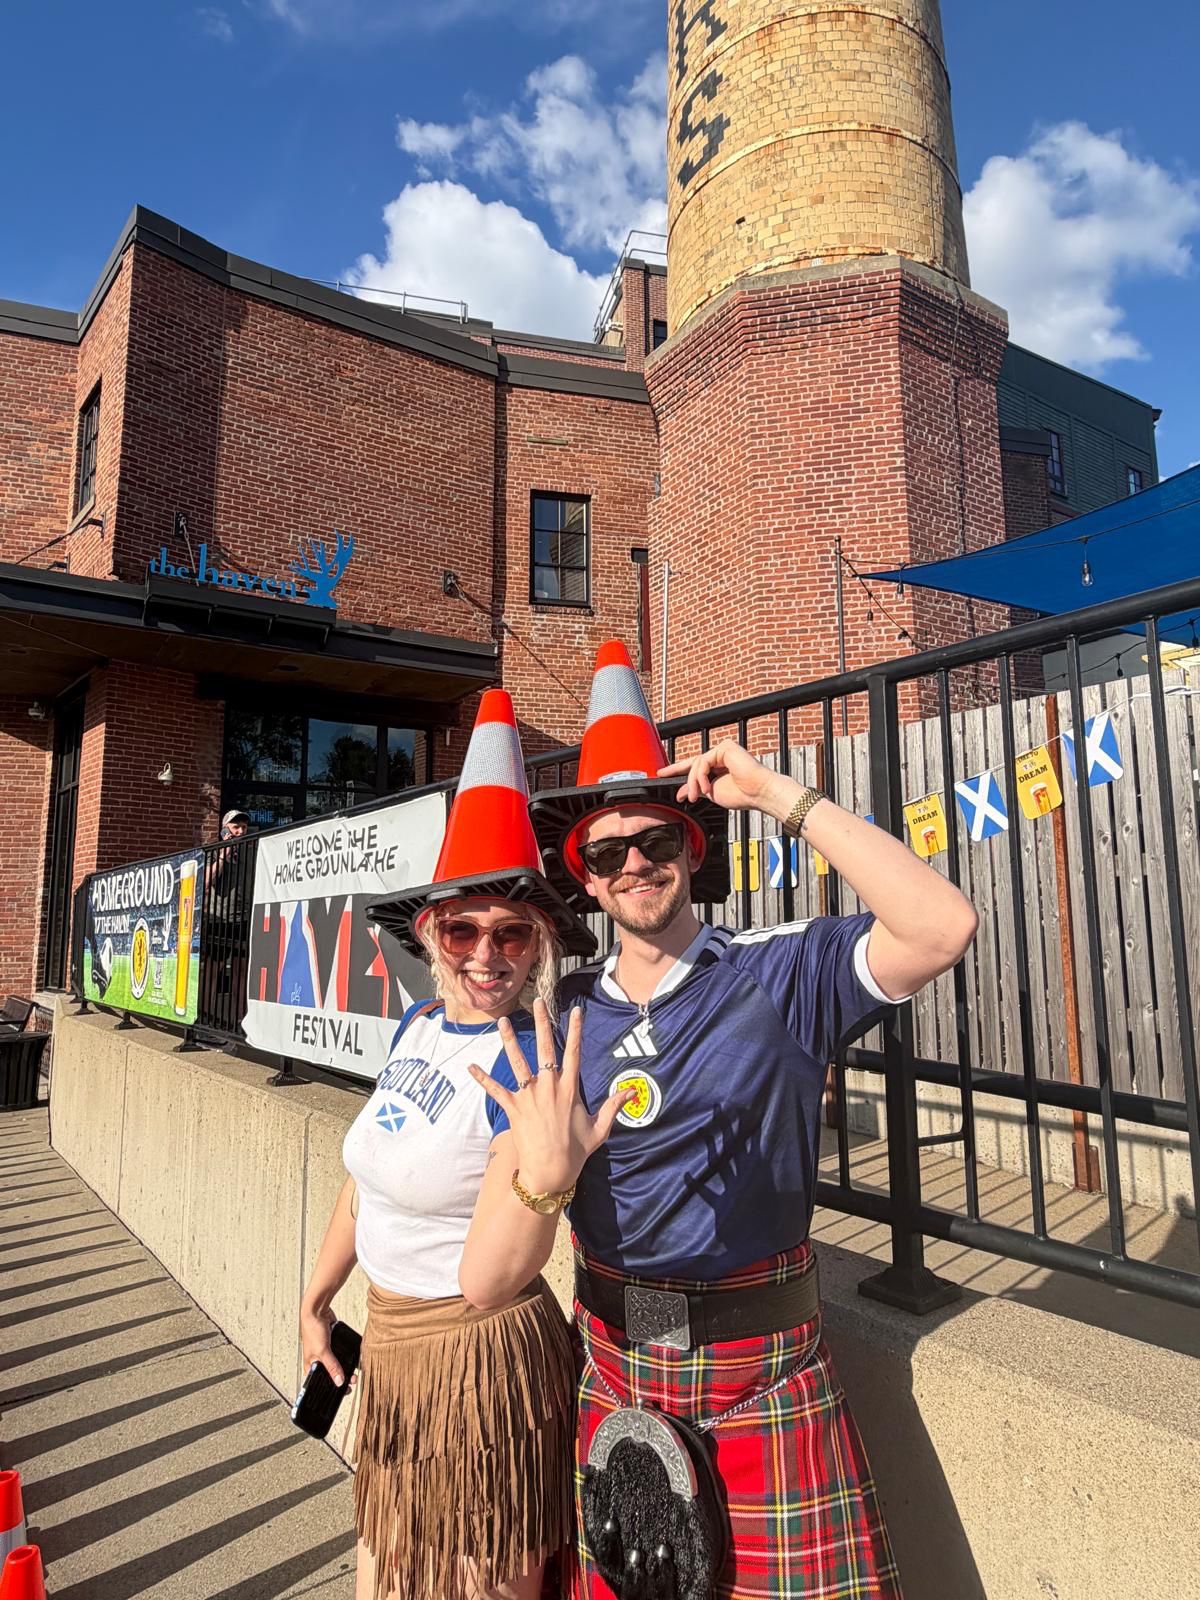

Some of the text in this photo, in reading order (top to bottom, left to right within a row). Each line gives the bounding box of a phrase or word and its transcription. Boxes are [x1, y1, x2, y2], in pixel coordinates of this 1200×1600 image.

[150, 543, 297, 599] the haven
[1018, 764, 1048, 783] DREAM
[912, 810, 938, 825] DREAM
[286, 829, 342, 861] WELCOME
[273, 861, 303, 885] HOME
[292, 1013, 363, 1056] FESTIVAL
[377, 1057, 457, 1126] SCOTLAND
